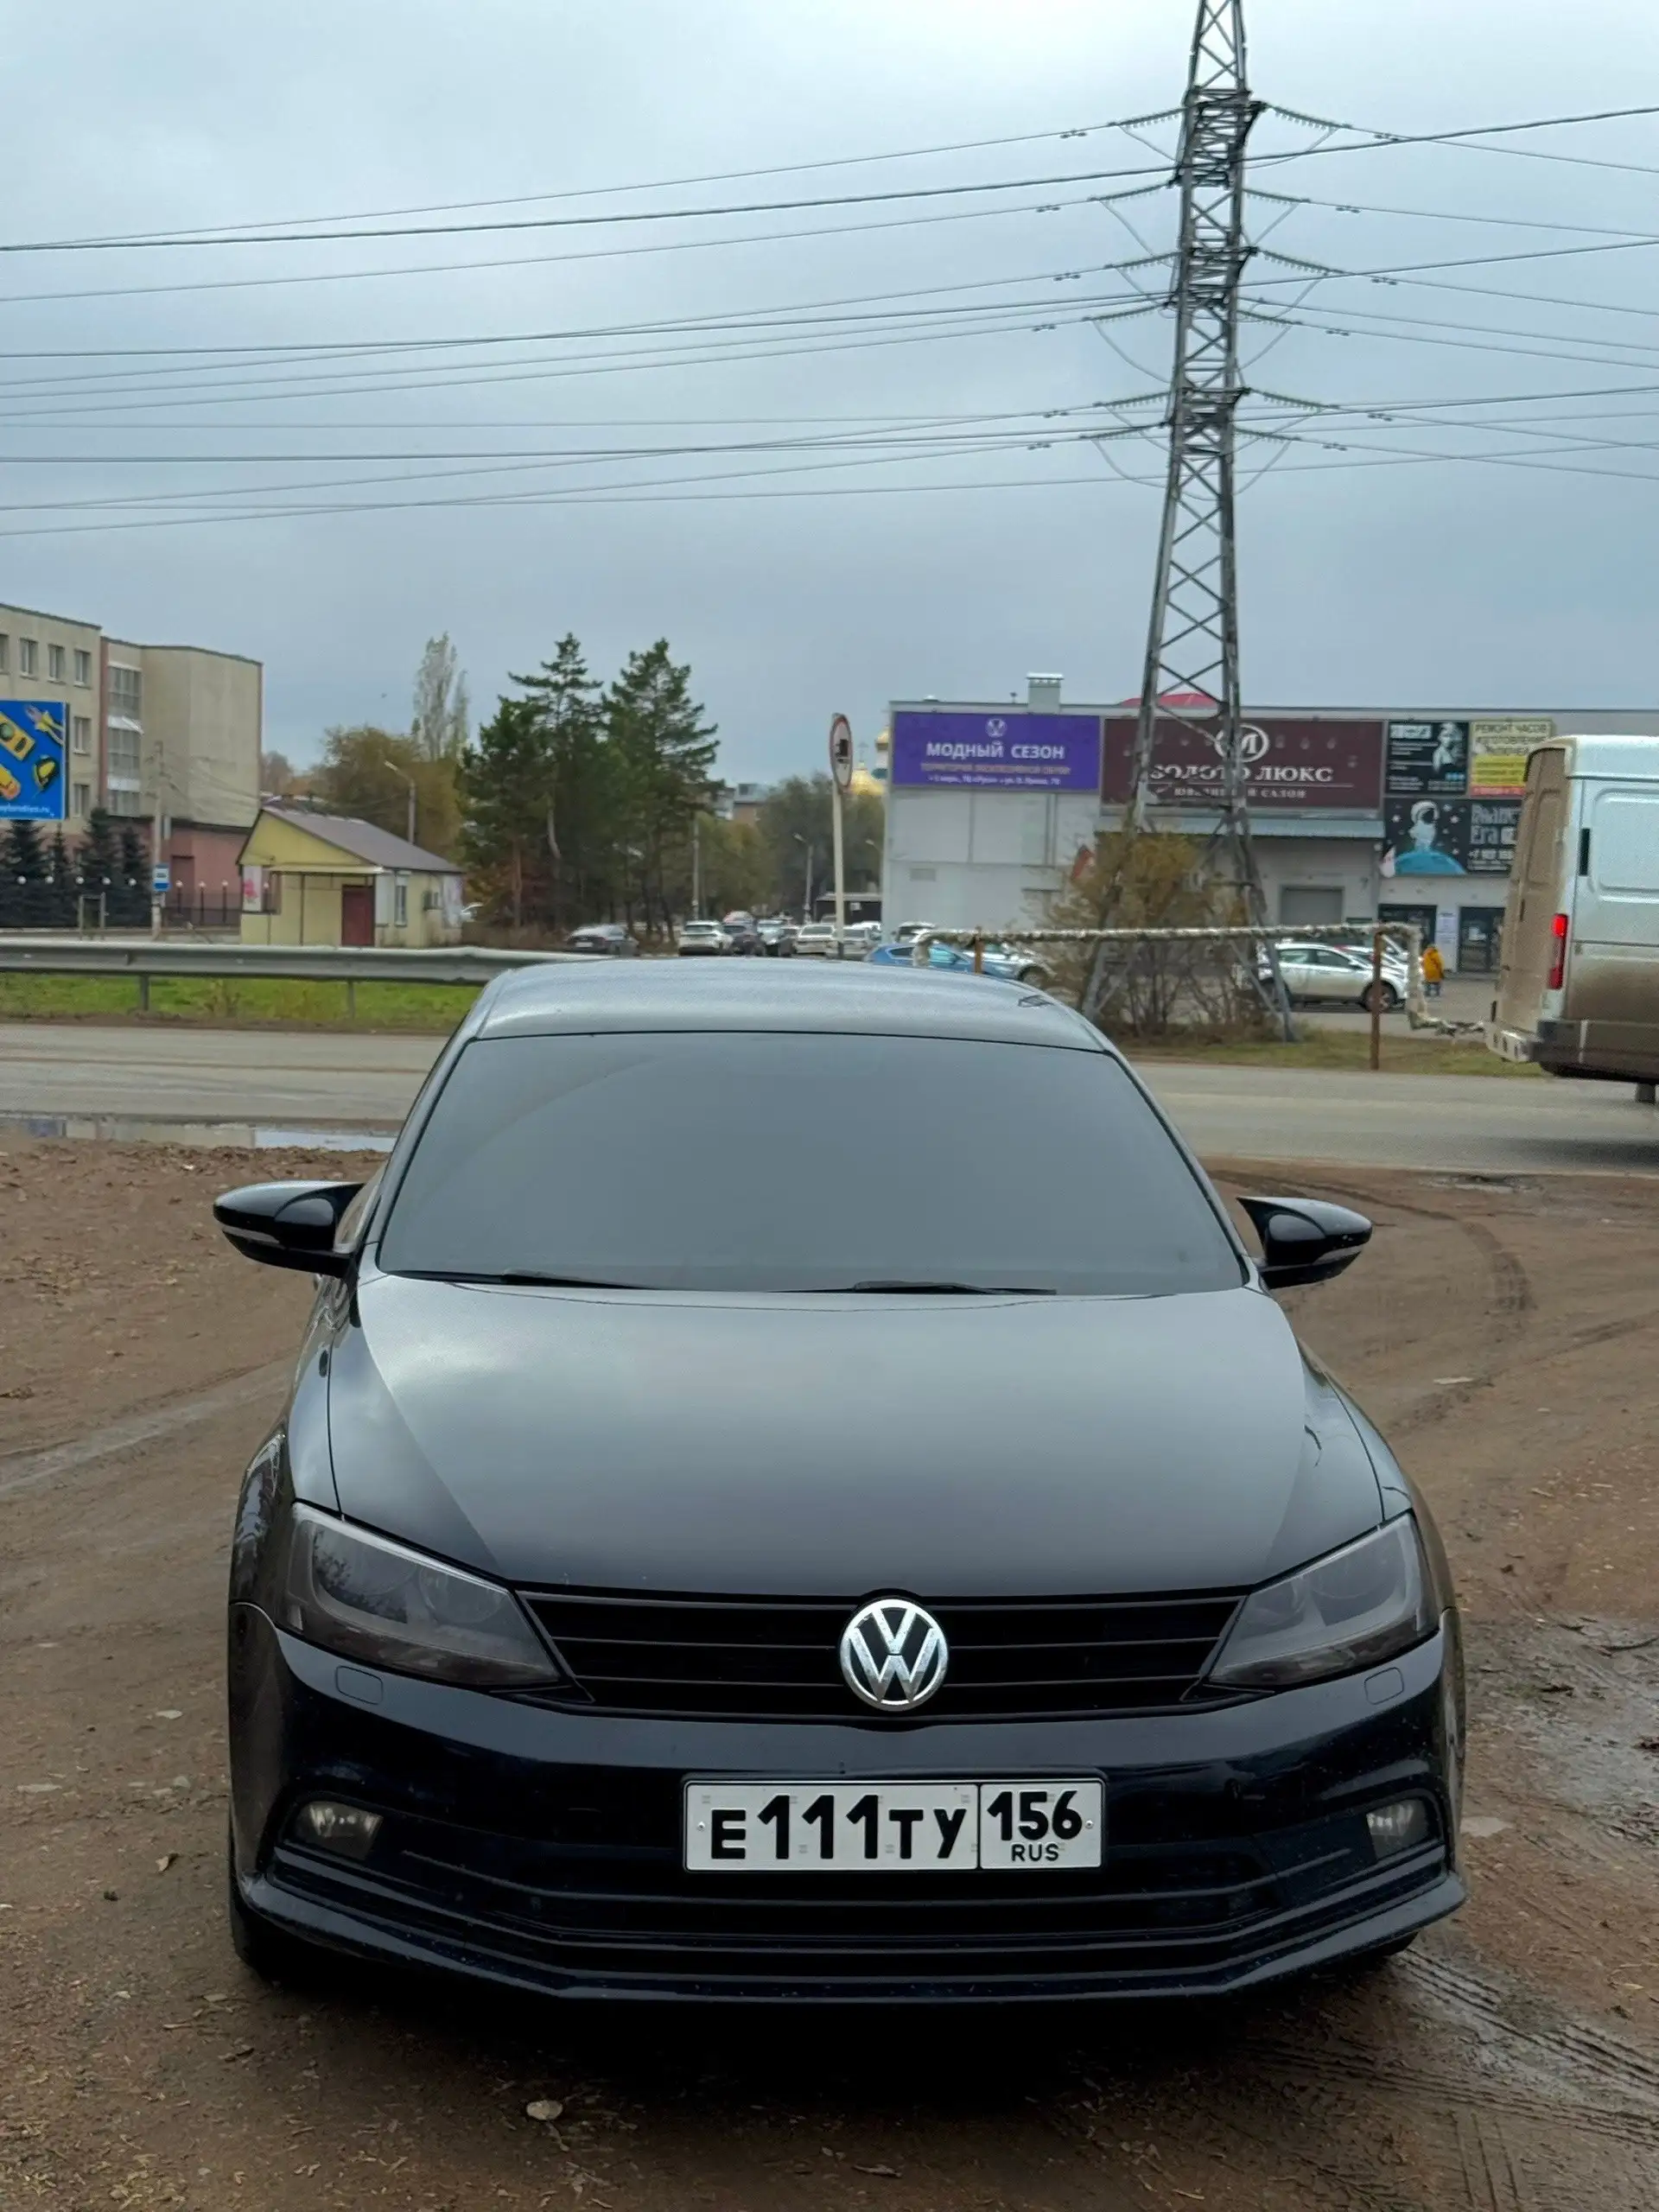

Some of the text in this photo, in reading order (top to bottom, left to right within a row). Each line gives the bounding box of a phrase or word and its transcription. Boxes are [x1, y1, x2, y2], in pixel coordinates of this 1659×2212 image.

[926, 741, 1065, 760] МОДНЫЙ СЕЗОН
[1255, 765, 1334, 782] ЛЮКС
[710, 1789, 1084, 1859] Е111ТУ 156
[1010, 1843, 1059, 1862] RUS
